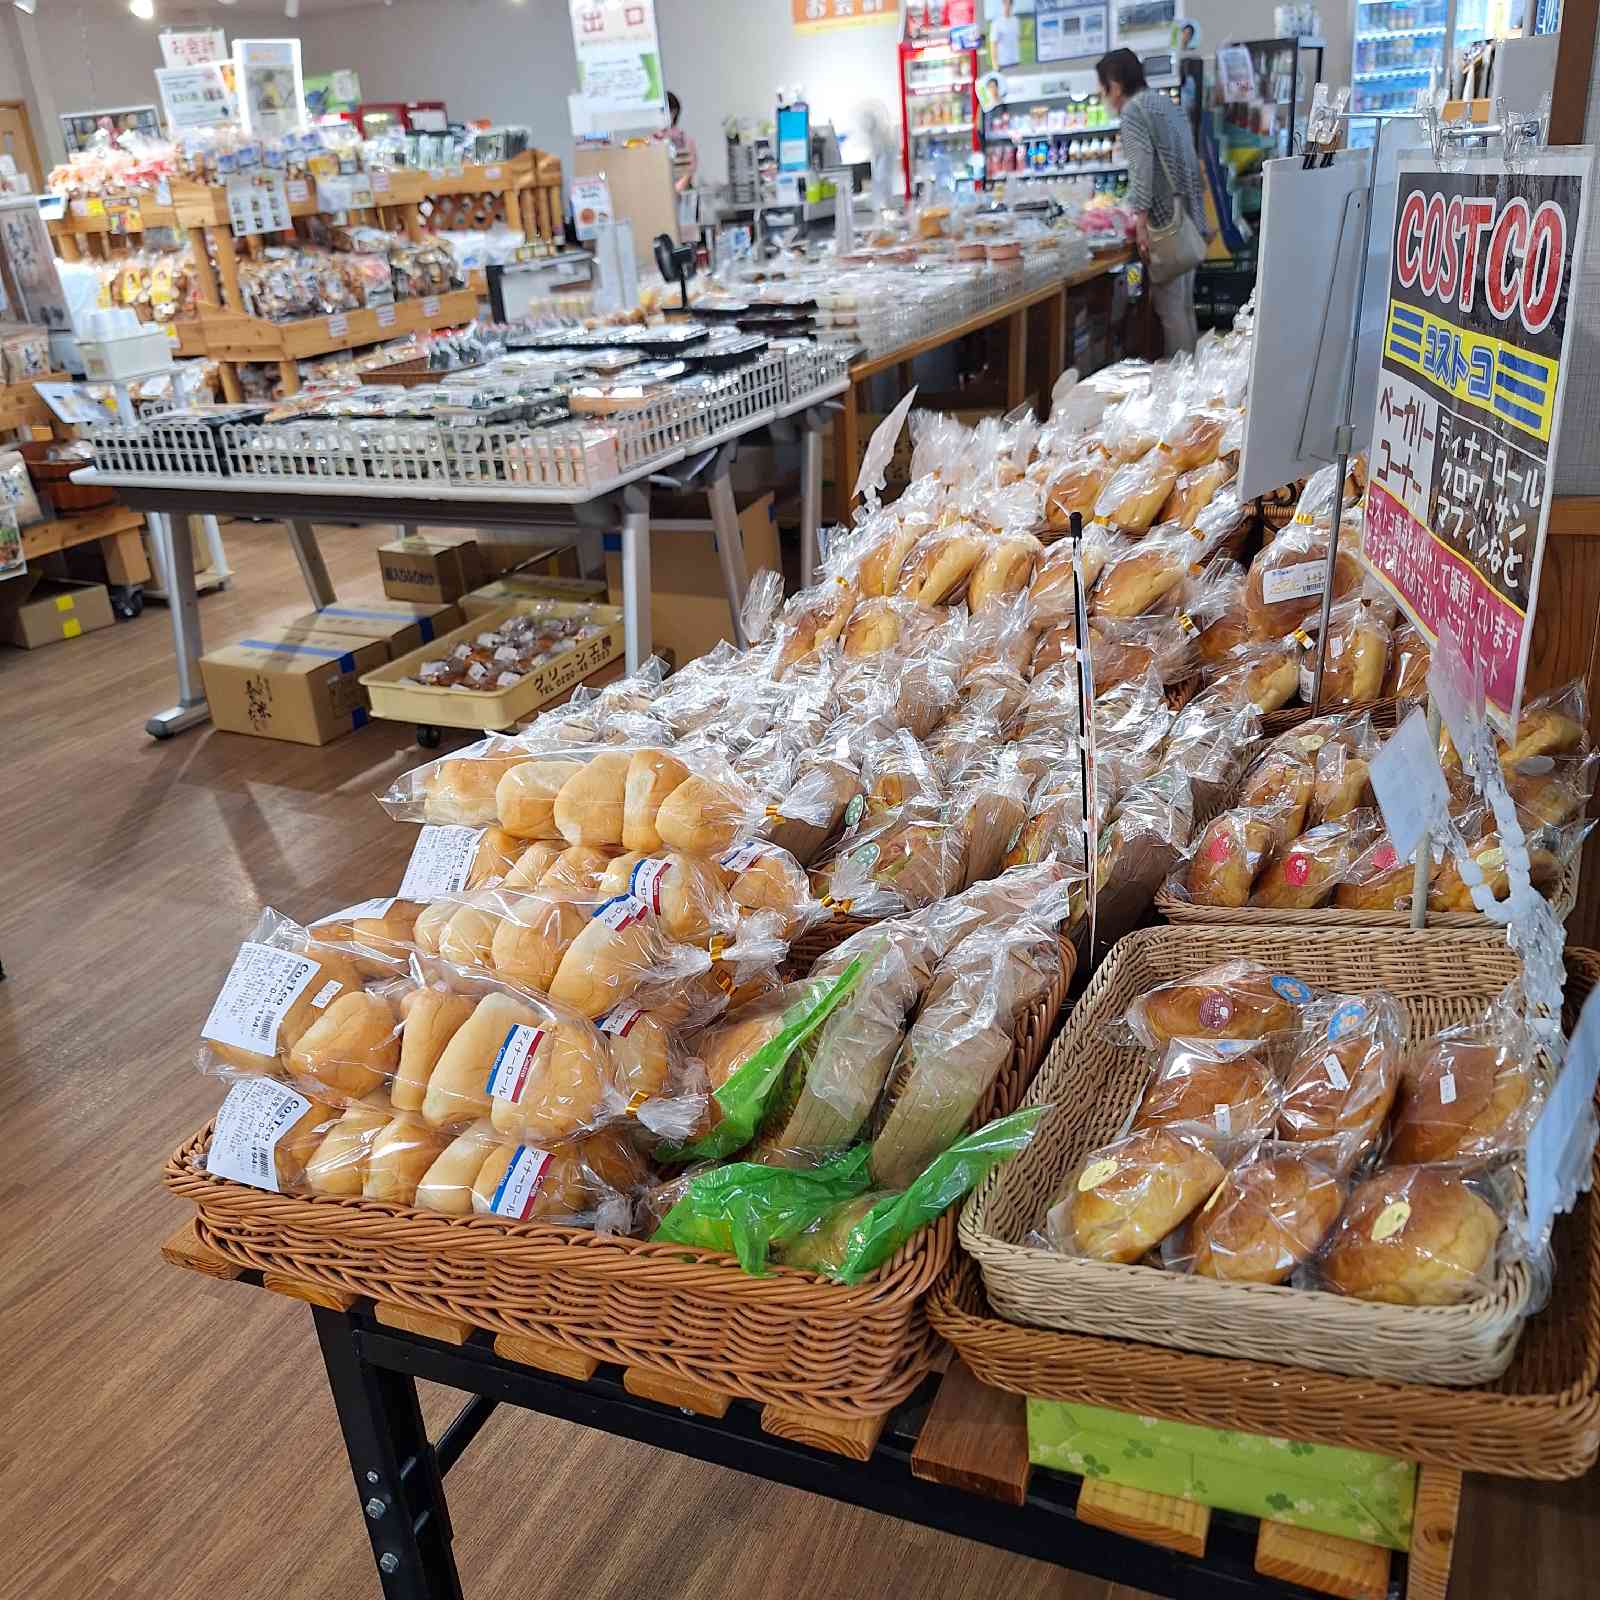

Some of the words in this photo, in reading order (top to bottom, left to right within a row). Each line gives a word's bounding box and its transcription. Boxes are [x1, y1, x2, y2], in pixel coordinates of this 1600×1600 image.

[1397, 190, 1566, 334] COSTCO
[1424, 326, 1494, 401] コストコ
[1380, 386, 1434, 453] ベーカリー
[1377, 438, 1422, 500] コーナー
[1441, 457, 1527, 541] クロワッサン
